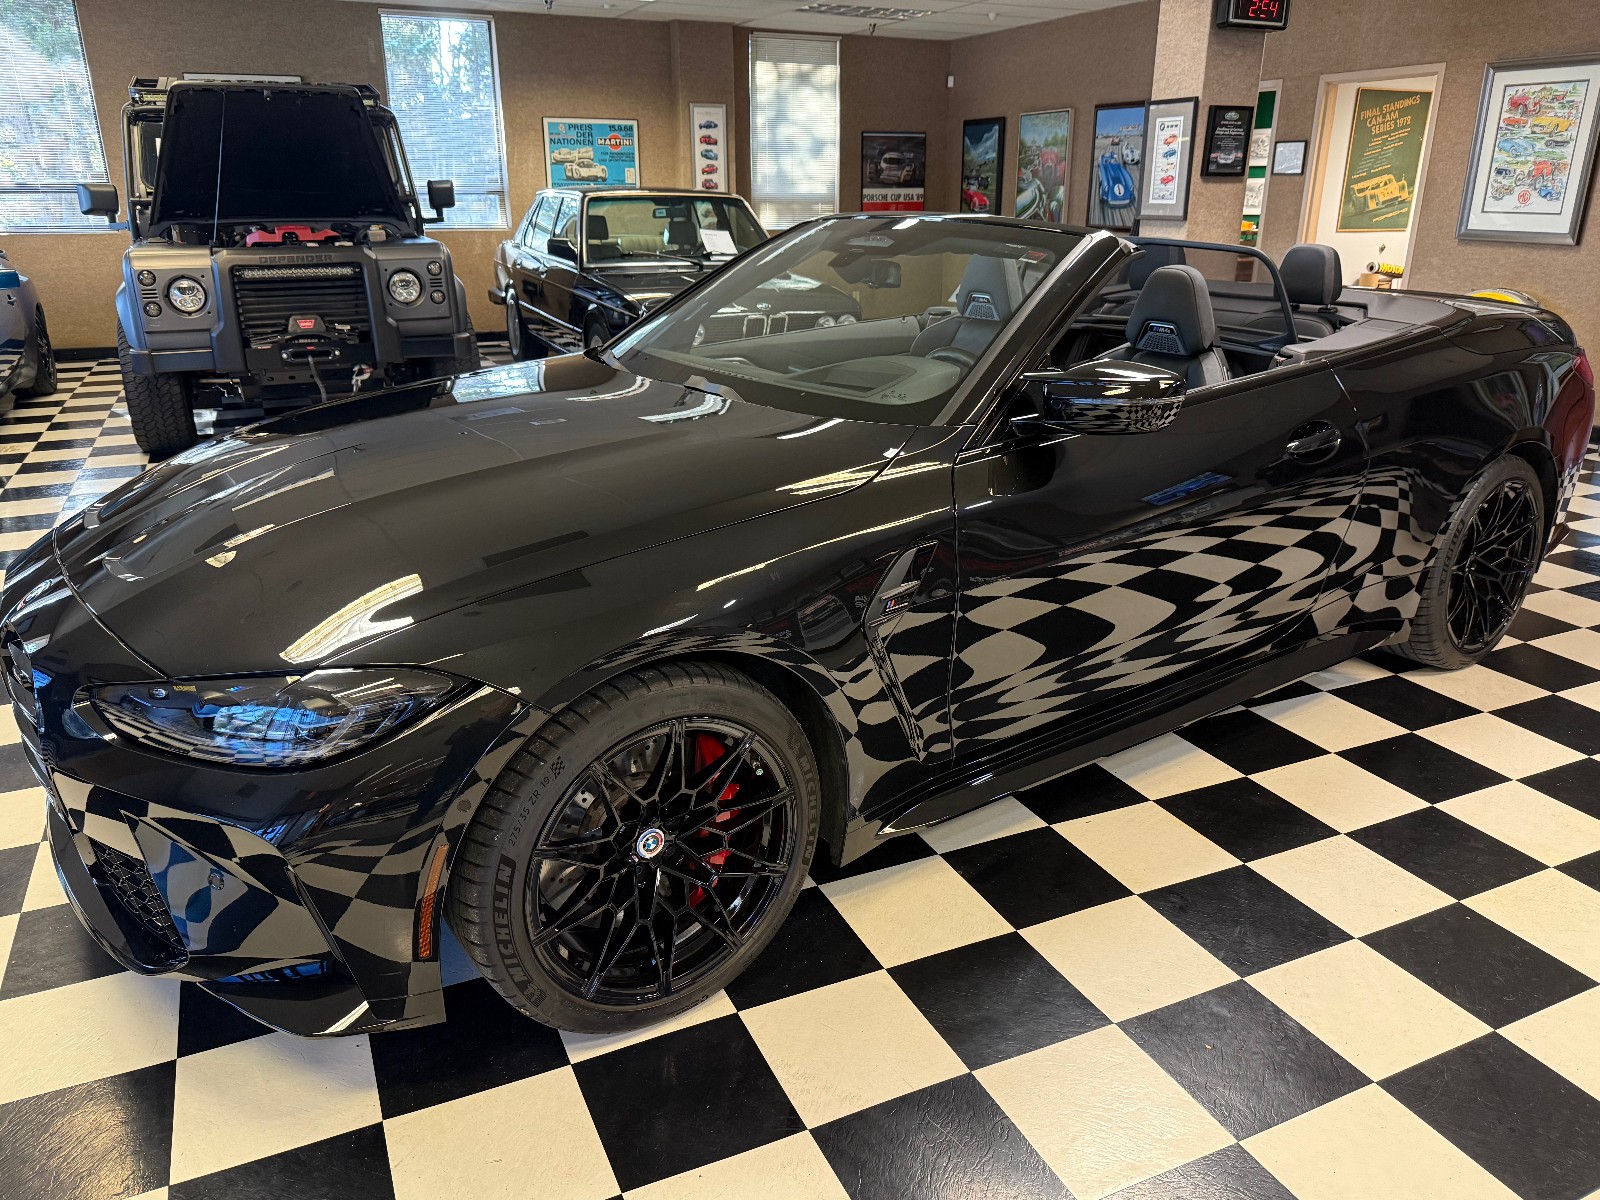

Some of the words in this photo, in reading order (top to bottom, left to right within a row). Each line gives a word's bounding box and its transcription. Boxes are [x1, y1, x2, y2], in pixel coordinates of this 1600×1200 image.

[1360, 107, 1381, 121] FINAL
[1382, 95, 1421, 114] STANDINGS
[1366, 111, 1399, 128] CAN-AM
[1371, 121, 1395, 135] SERIES
[1396, 116, 1412, 128] 1972
[568, 123, 593, 132] PREIS
[608, 124, 634, 132] 15.9.68
[549, 137, 594, 146] NATIONEN
[597, 138, 633, 146] MARTINI
[863, 193, 888, 202] PORSCHE
[890, 193, 901, 202] CUP
[903, 192, 915, 201] USA
[259, 254, 333, 264] DEFENDER
[508, 806, 530, 847] 275/35
[529, 789, 541, 806] ZR
[540, 776, 551, 788] 19
[799, 755, 819, 860] MICHELIN
[495, 861, 528, 987] MICHELIN
